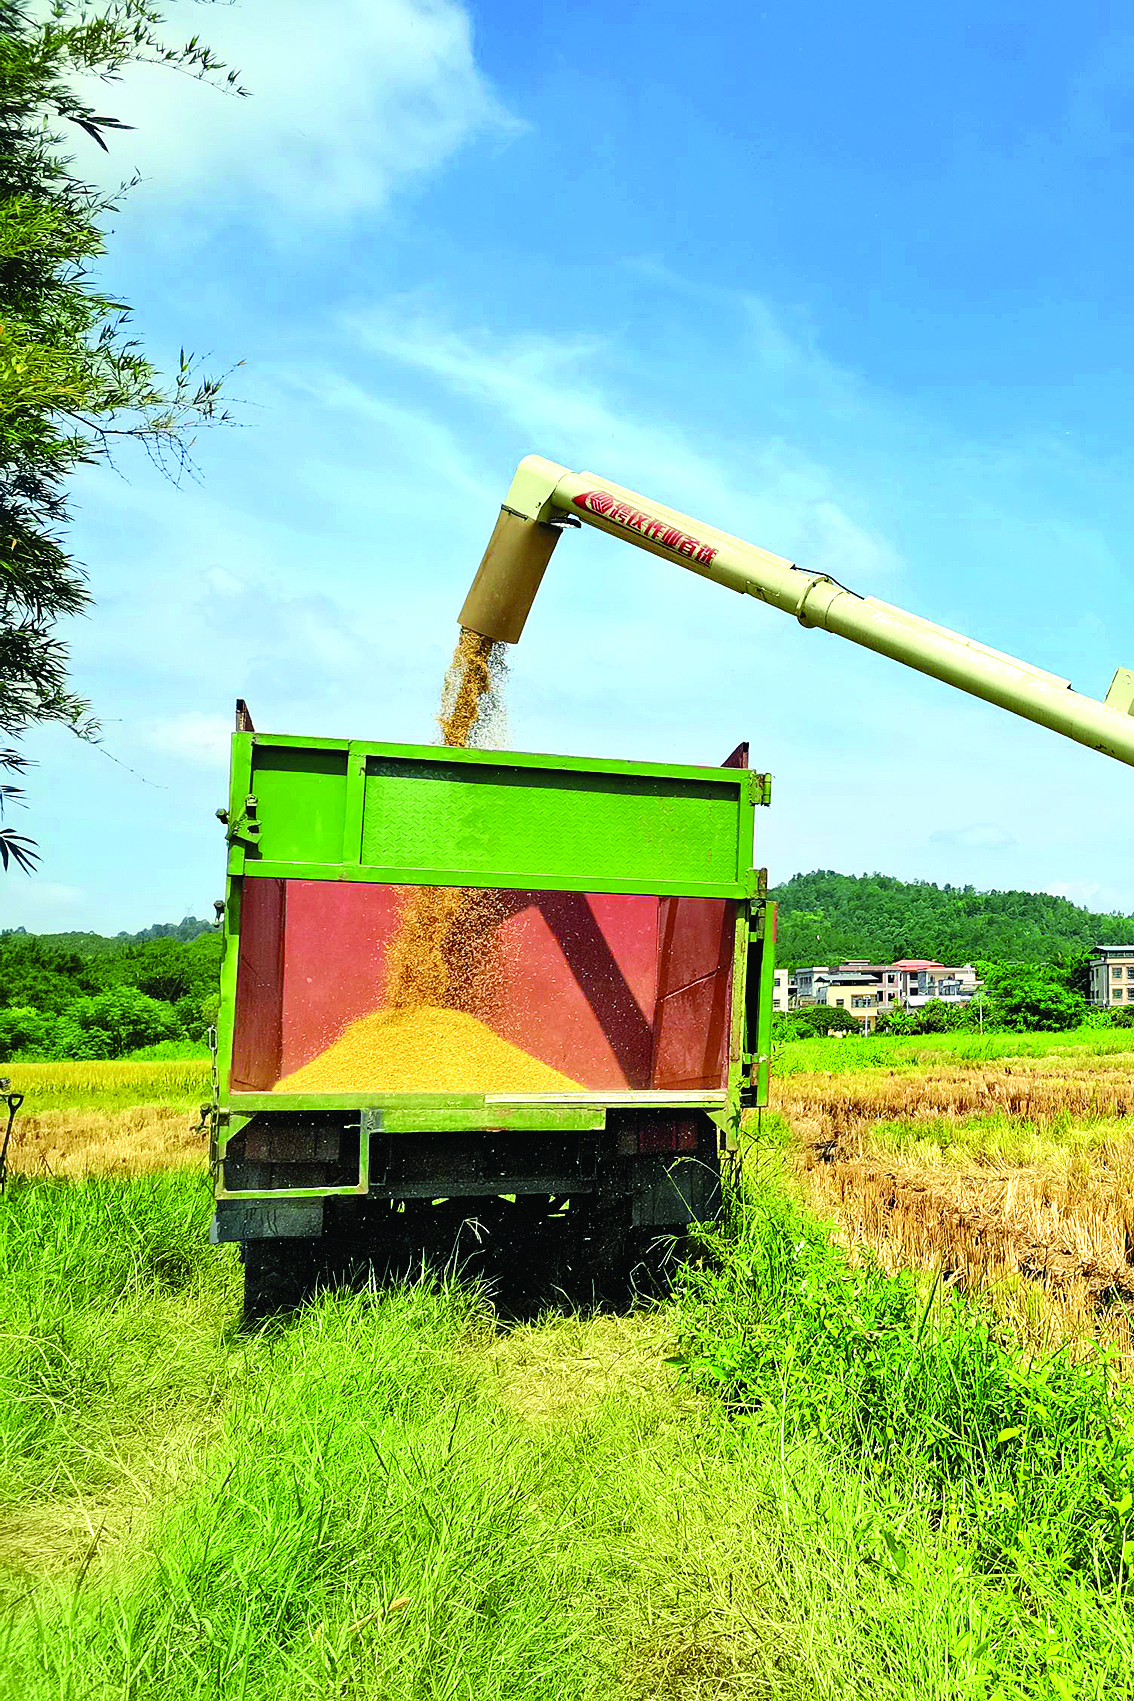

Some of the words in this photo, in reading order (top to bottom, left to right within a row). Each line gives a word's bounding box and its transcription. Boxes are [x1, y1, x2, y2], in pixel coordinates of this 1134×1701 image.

[609, 502, 717, 566] 跨区作业首选
